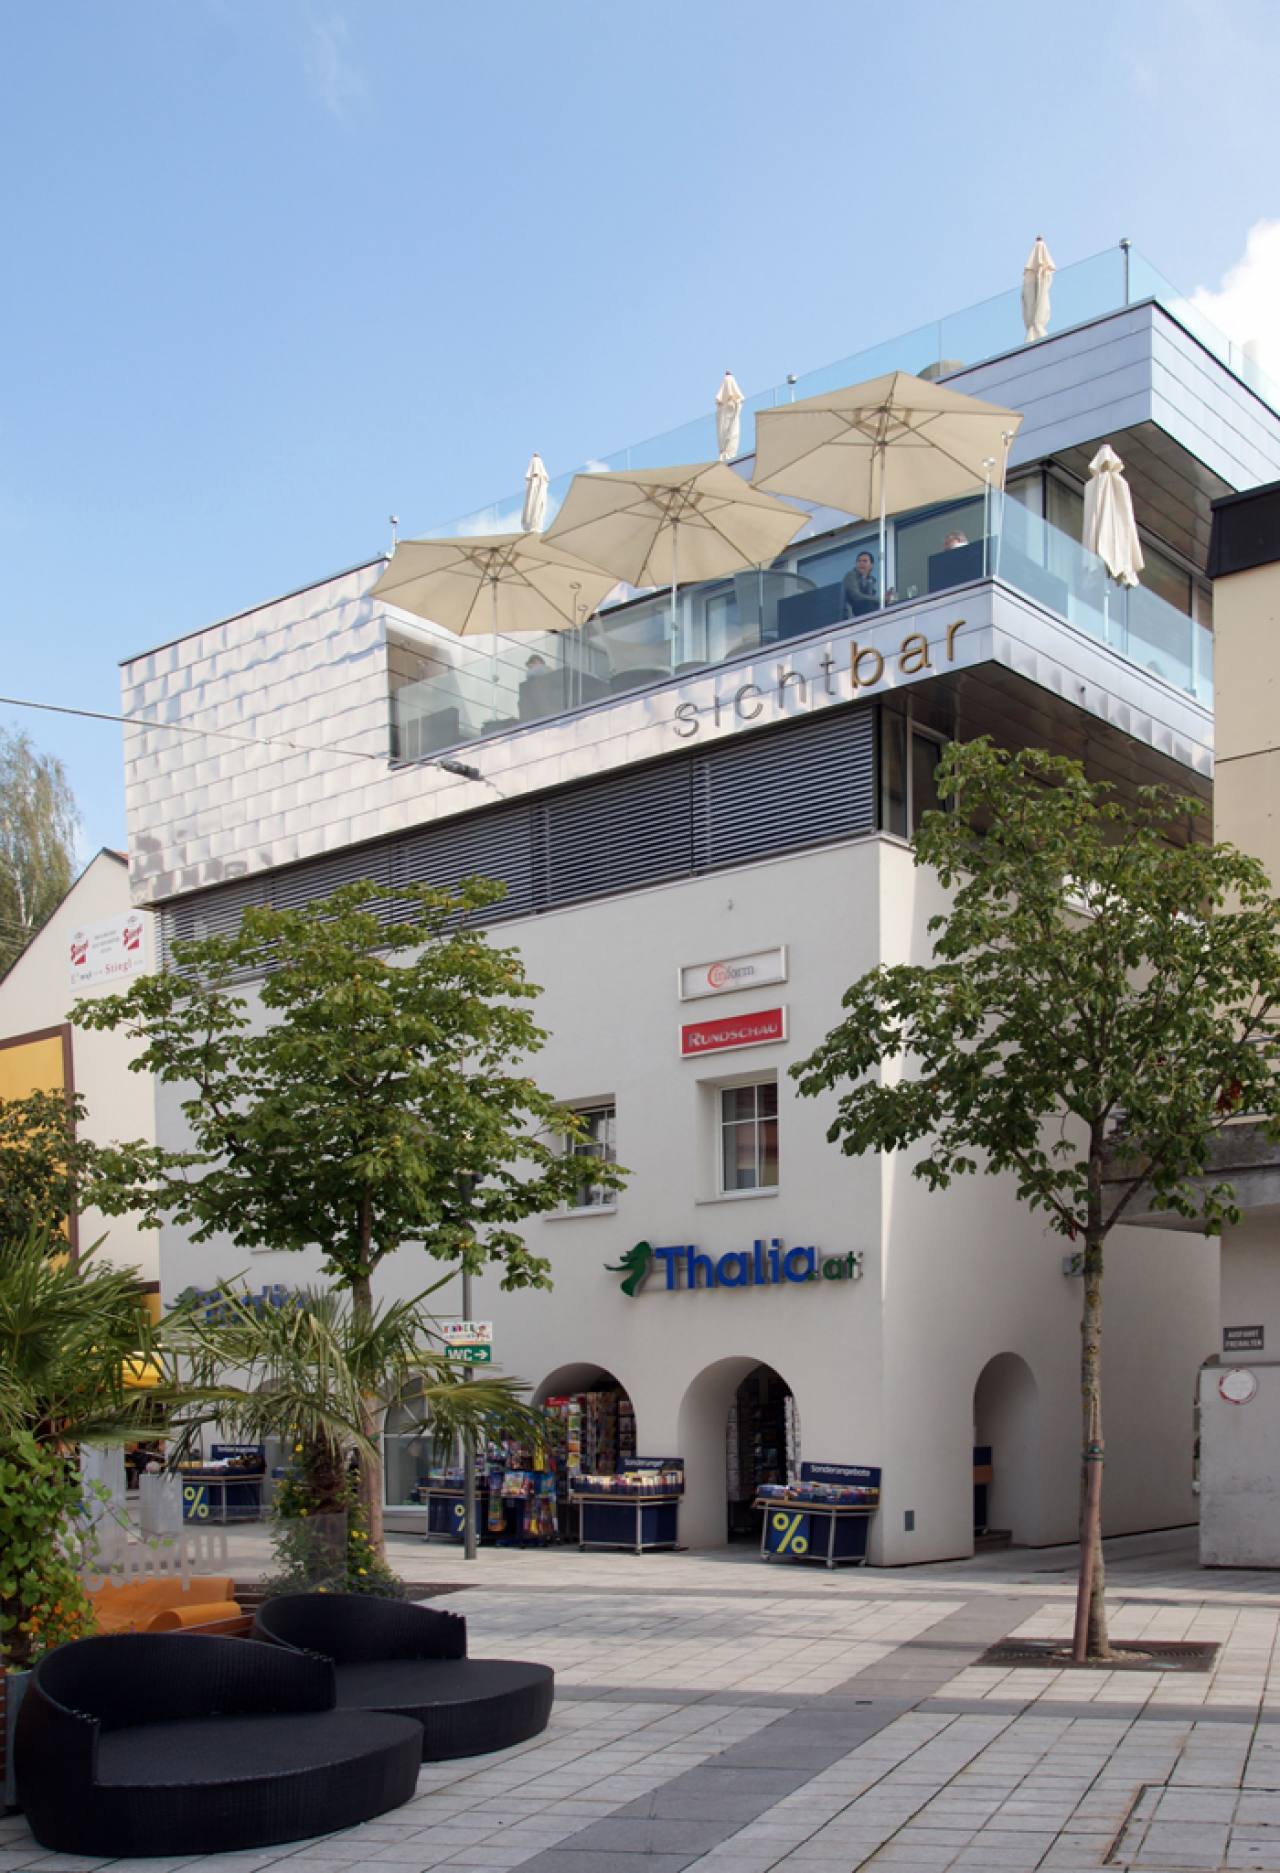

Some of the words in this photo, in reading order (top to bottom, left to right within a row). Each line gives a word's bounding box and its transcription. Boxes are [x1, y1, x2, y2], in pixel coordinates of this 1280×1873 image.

[673, 619, 966, 738] sichtbar
[447, 1348, 473, 1361] WC
[772, 1512, 808, 1553] %
